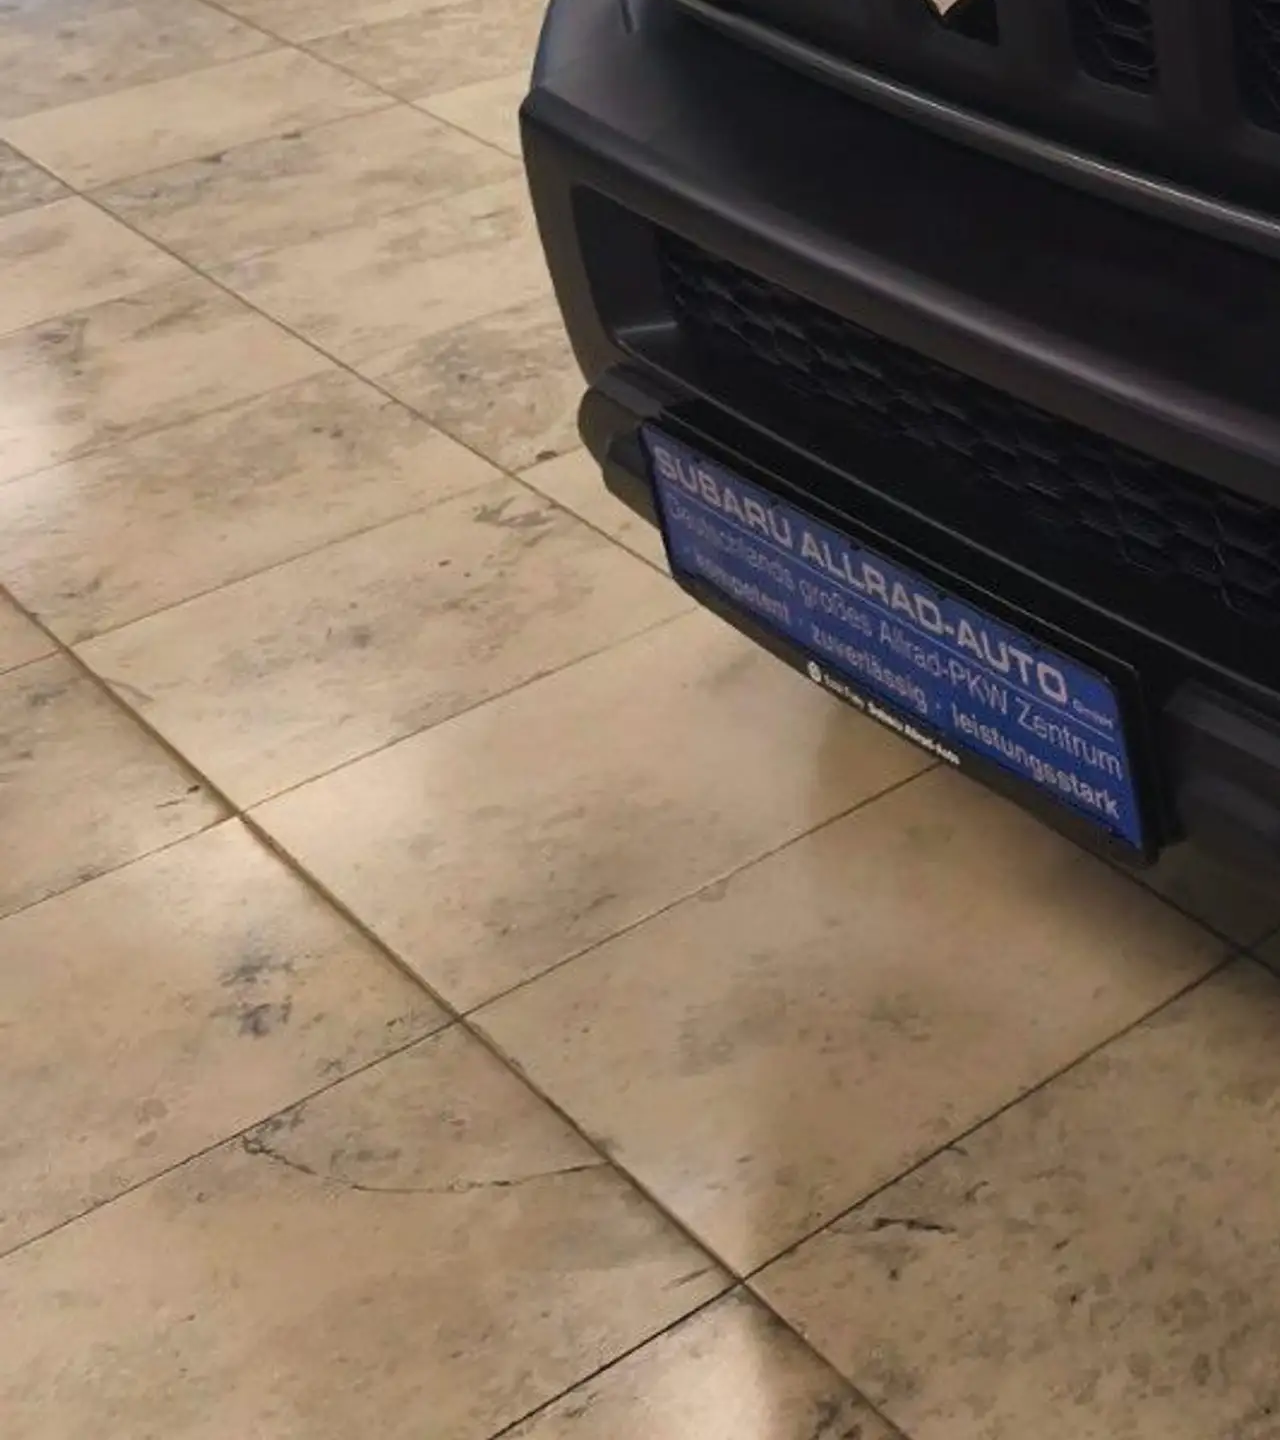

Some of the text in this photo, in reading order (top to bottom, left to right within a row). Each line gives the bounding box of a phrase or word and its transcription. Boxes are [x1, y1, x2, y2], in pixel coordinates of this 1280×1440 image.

[654, 445, 794, 550] SUBARU
[802, 531, 1068, 706] ALLRAD-AUTO
[952, 701, 1120, 820] leistungsstark
[1014, 695, 1123, 781] Zentrum
